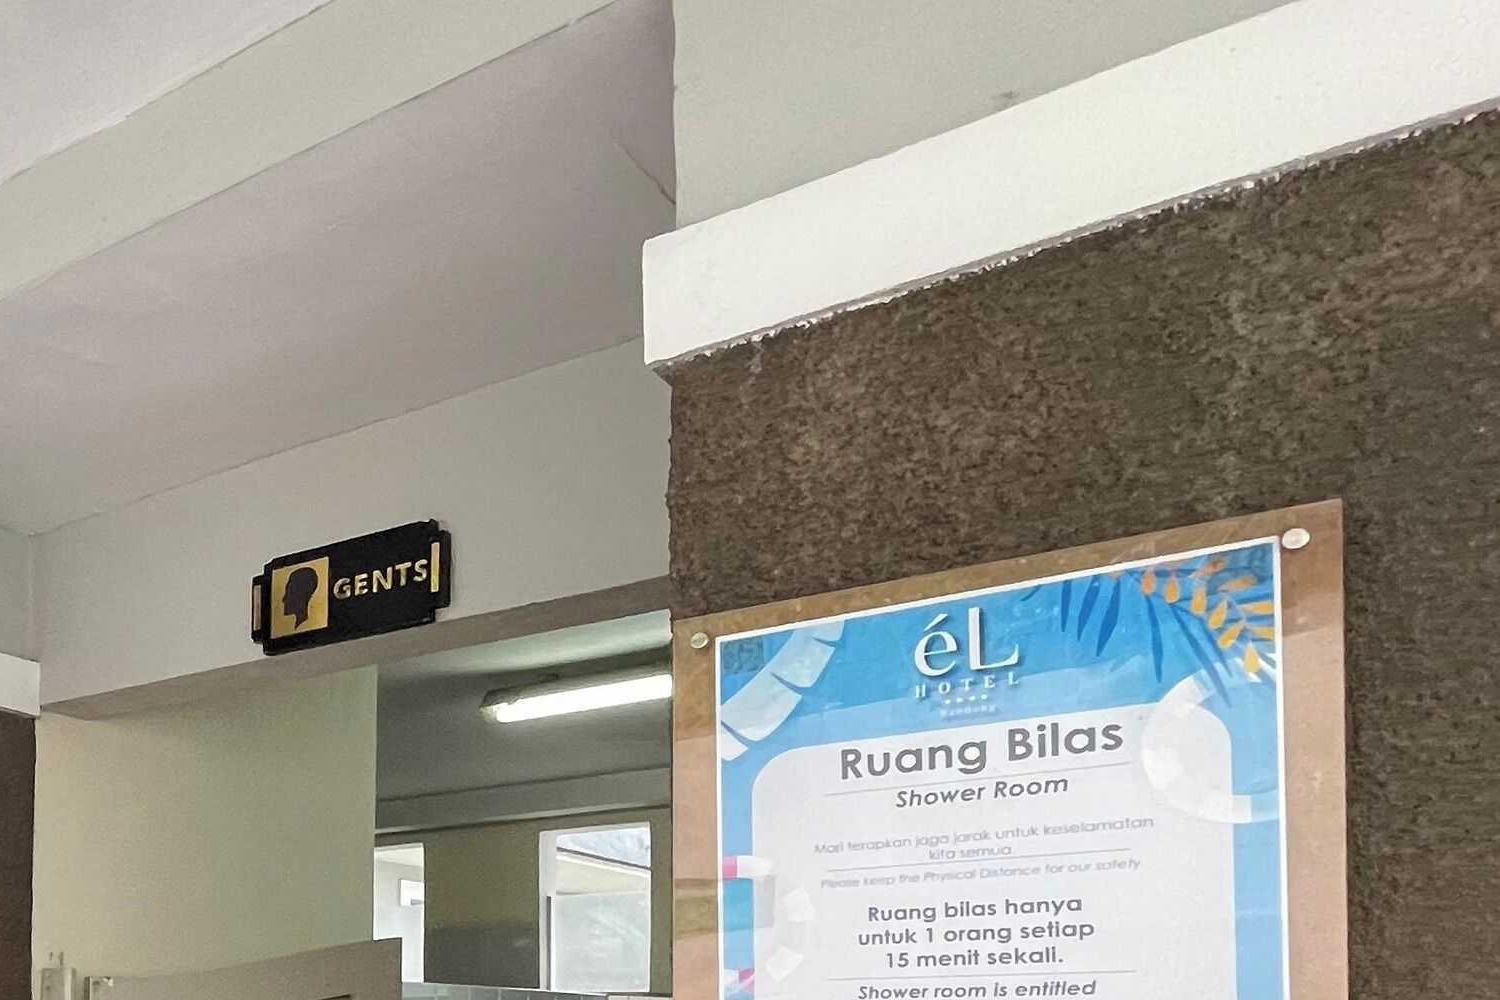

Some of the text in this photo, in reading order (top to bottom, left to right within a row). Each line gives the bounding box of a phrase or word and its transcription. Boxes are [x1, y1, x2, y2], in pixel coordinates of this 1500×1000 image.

[333, 559, 428, 600] GENTS
[914, 671, 1020, 700] HOTEL
[841, 722, 1123, 780] Ruang Bilas
[896, 778, 1069, 809] Shower Room
[814, 817, 1154, 854] Mari terapkan jaga jarak untuk keselamatan
[928, 848, 956, 860] kita
[923, 868, 976, 883] Physical
[979, 863, 1041, 879] Distance
[1045, 863, 1064, 874] for
[1067, 862, 1092, 873] our
[1095, 858, 1141, 871] safety
[868, 898, 1083, 923] Ruang bilas hanya
[858, 921, 1095, 945] untuk 1 orang setiap
[886, 947, 1064, 968] 15 menit sekali.
[858, 980, 1097, 1000] Shower room is entitled
